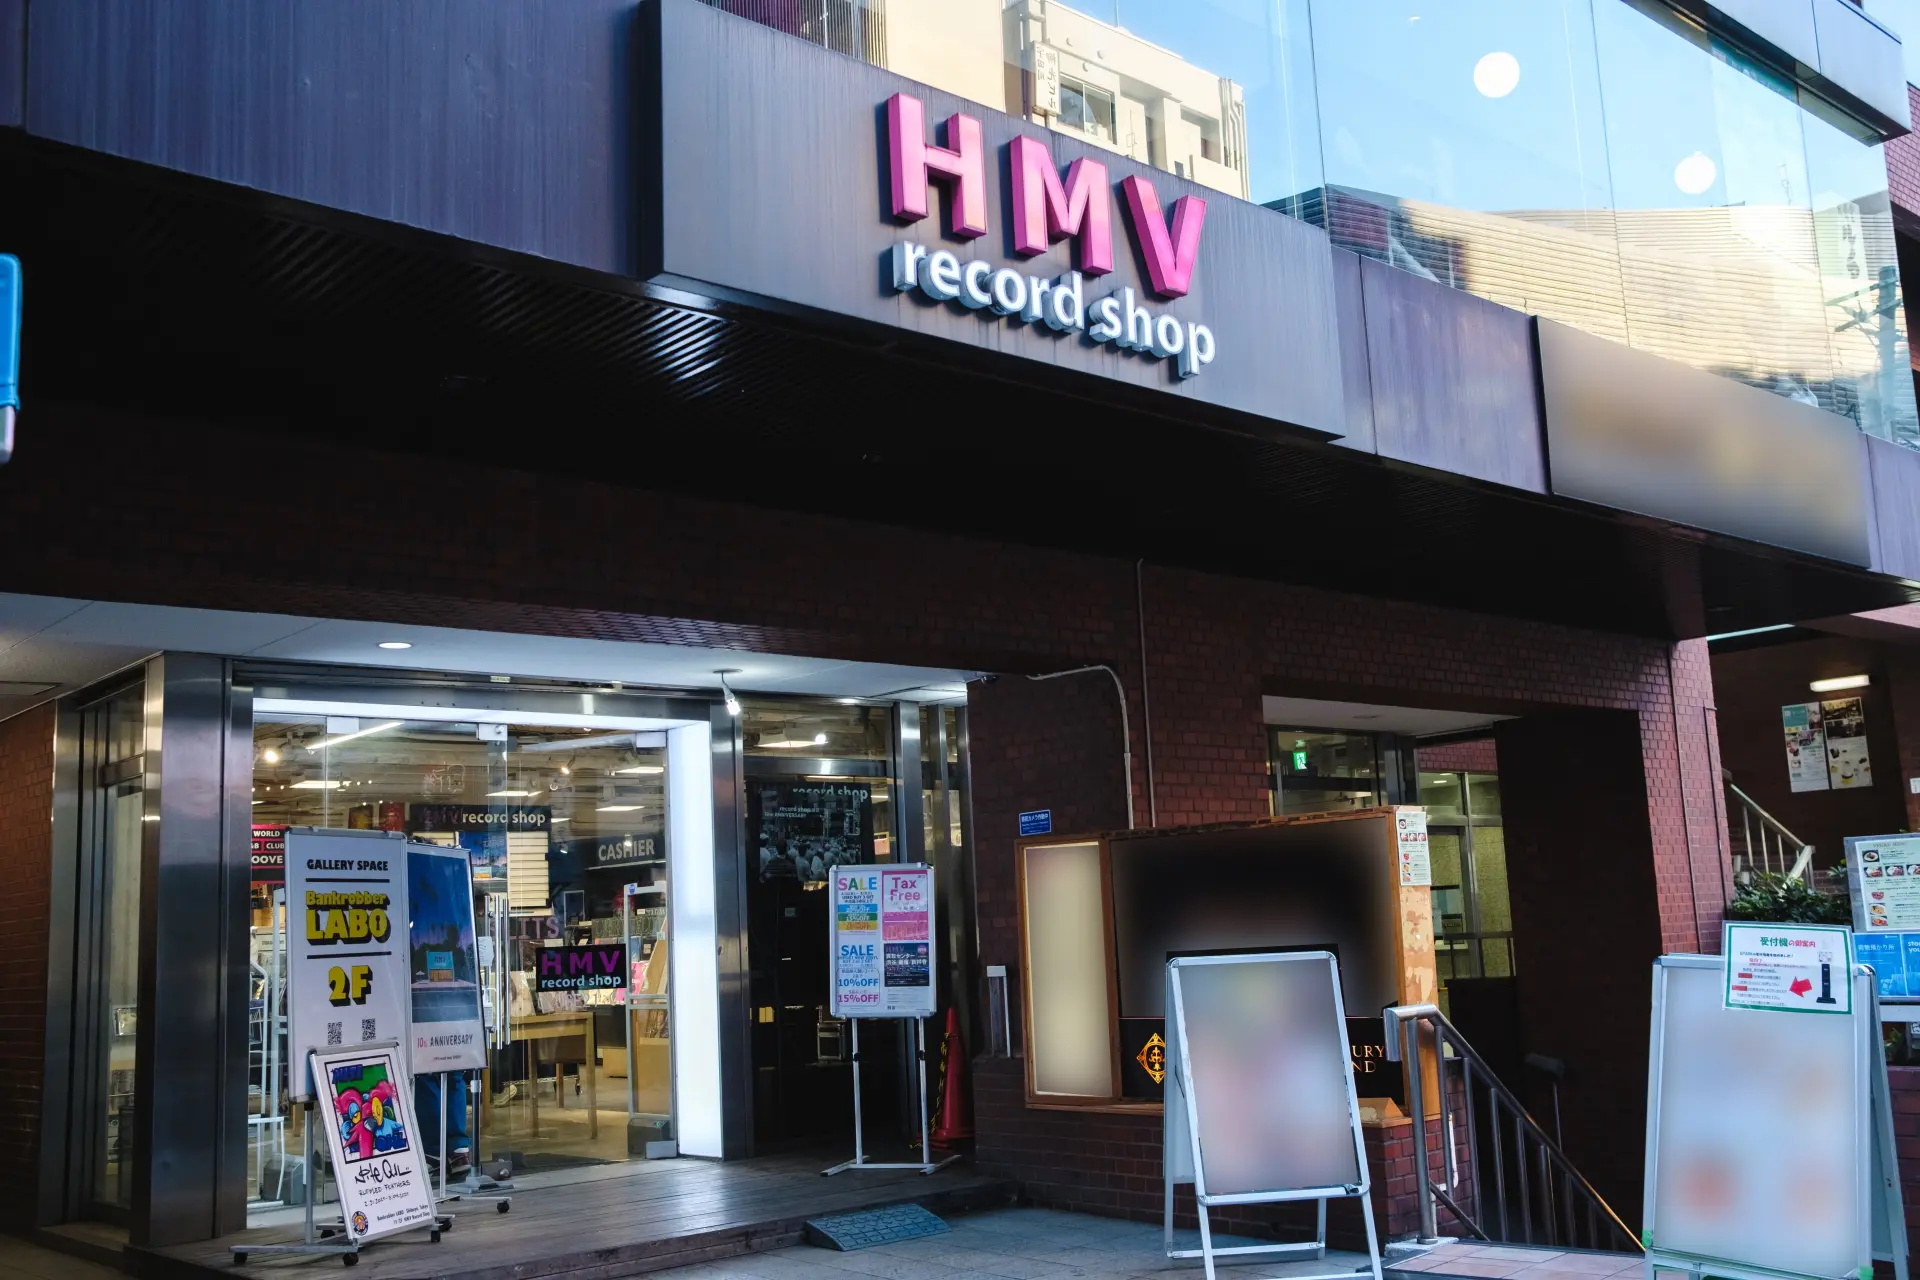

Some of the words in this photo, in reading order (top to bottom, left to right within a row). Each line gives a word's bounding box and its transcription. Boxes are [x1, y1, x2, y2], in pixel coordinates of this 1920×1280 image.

[887, 91, 1207, 298] HMV
[892, 240, 1085, 333] record
[1089, 286, 1215, 378] shop
[463, 807, 509, 823] record
[512, 807, 546, 826] shop
[253, 830, 281, 838] WORLD
[266, 842, 285, 850] CLUB
[598, 838, 655, 861] CASHIER
[307, 858, 354, 871] GALLERY
[357, 860, 388, 871] SPACE
[838, 877, 877, 891] SALE
[892, 876, 917, 889] Tax
[305, 890, 391, 909] Bankrobber
[890, 889, 921, 901] Free
[305, 908, 392, 946] LABO
[1760, 936, 1816, 948] 受付機の御案内
[841, 944, 874, 956] SALE
[541, 950, 621, 976] HMV
[328, 965, 374, 1007] 2F
[541, 974, 586, 989] record
[588, 974, 622, 988] shop
[838, 978, 879, 987] 10%OFF
[838, 994, 879, 1003] 15%OFF
[429, 1033, 474, 1047] ANNIVERSARY
[383, 1180, 411, 1191] FEATHERS
